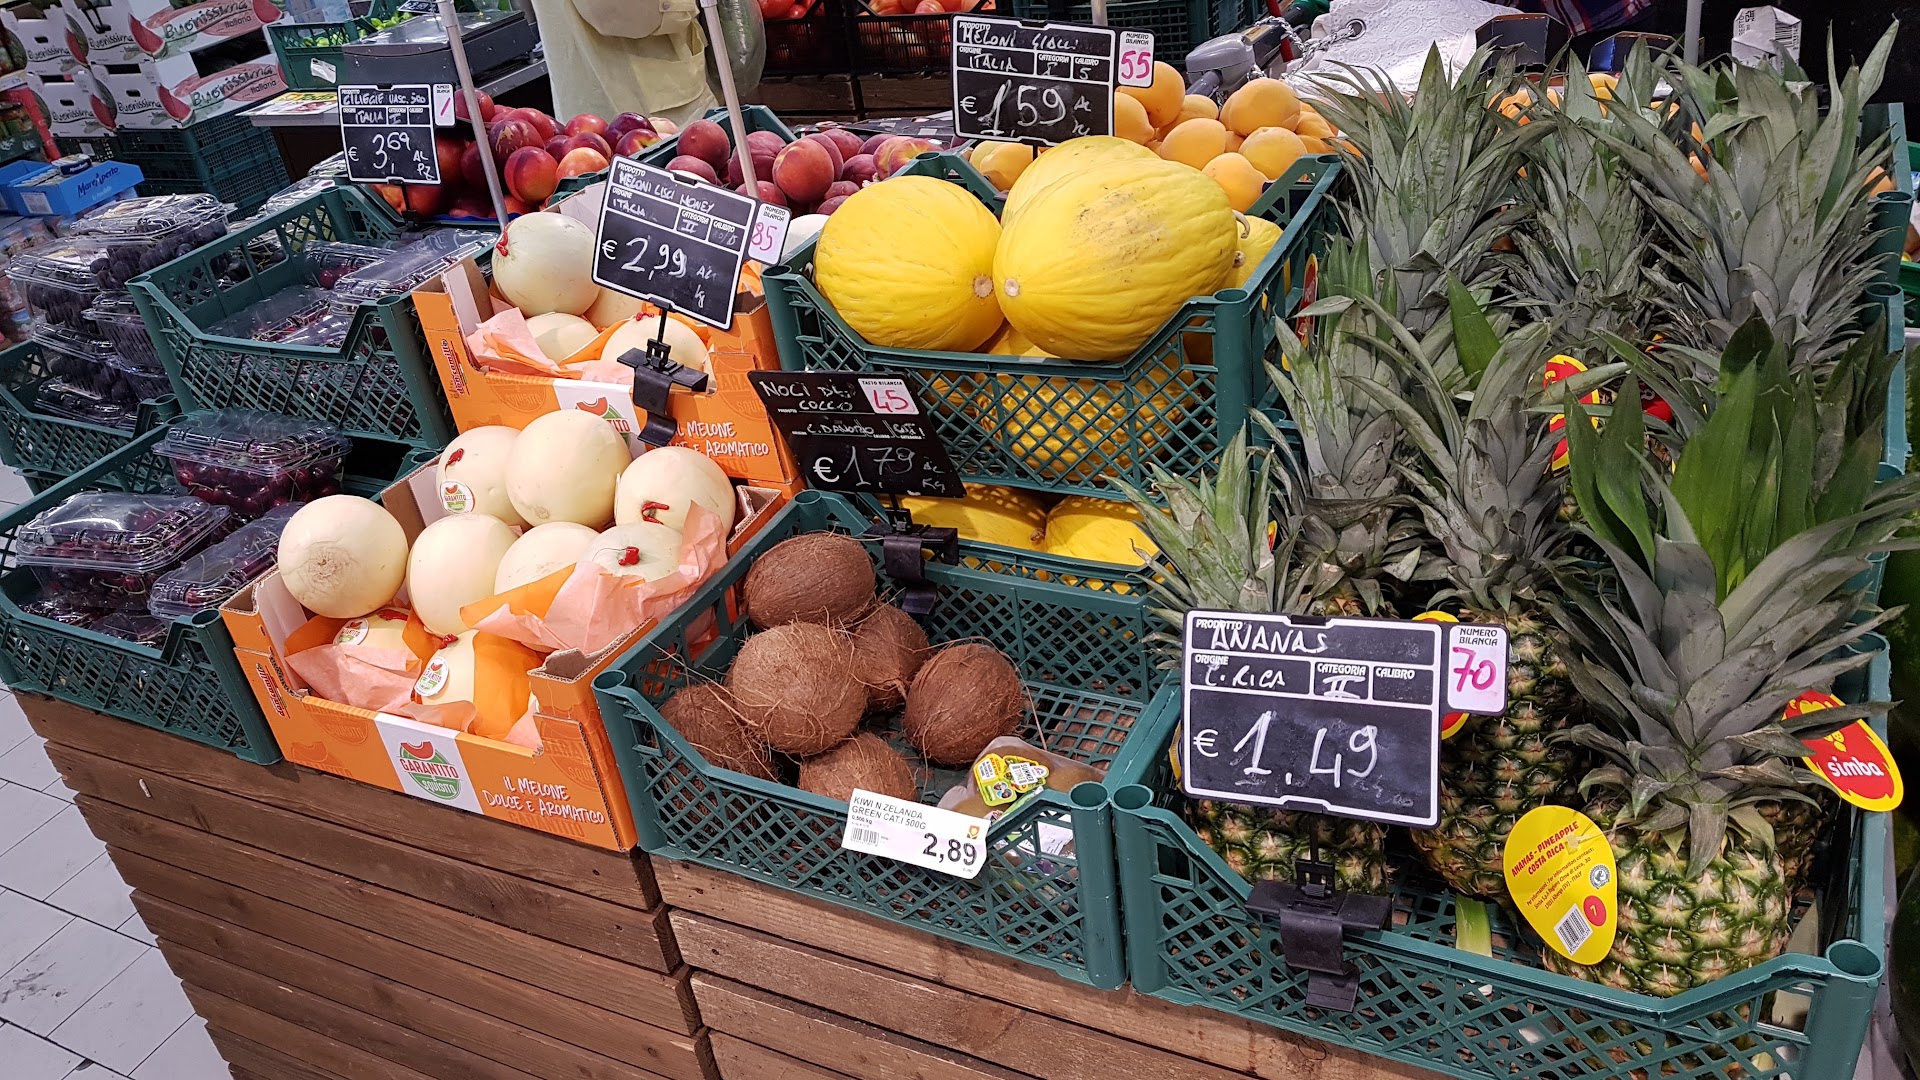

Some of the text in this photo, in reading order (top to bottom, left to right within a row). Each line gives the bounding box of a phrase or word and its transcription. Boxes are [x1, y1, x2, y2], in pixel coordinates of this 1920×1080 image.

[164, 1, 249, 39] Buonissima
[959, 22, 990, 31] PRODOTTO
[969, 54, 1018, 72] ITALIA
[1038, 53, 1069, 63] CATEGORIA
[1075, 56, 1099, 66] CALIBRO
[1121, 51, 1151, 79] 55
[191, 65, 272, 105] Buonissima
[343, 93, 384, 105] CILIEGIE
[960, 96, 977, 114] €
[348, 147, 359, 161] €
[617, 163, 646, 176] PRODOTTO
[619, 172, 651, 192] MELONI
[654, 185, 676, 199] LISCI
[613, 198, 646, 217] ITALIA
[681, 219, 699, 233] II
[751, 222, 778, 251] 85
[602, 240, 617, 260] €
[759, 381, 811, 397] NOCI
[799, 400, 853, 412] COCCO
[873, 390, 910, 413] 45
[687, 420, 737, 438] MELONE
[705, 439, 769, 457] AROMATICO
[813, 457, 839, 483] €
[1195, 618, 1243, 632] PRODOTTO
[1459, 627, 1498, 637] NUMERO
[1211, 623, 1328, 654] ANANAS
[1458, 636, 1499, 647] BILANCIA
[1194, 654, 1229, 667] ORIGINE
[1316, 662, 1367, 677] CATEGORIA
[1452, 646, 1497, 693] 70
[1375, 665, 1416, 681] CALIBRO
[1323, 674, 1366, 700] II
[1193, 729, 1219, 758] €
[400, 758, 459, 779] GARANTITO
[1827, 756, 1885, 777] simba
[503, 775, 570, 801] IL MELONE
[482, 790, 605, 824] DOLCE E AROMATICO
[853, 796, 873, 808] KIWI
[851, 806, 882, 819] GREEN
[905, 818, 927, 830] 500G
[922, 832, 977, 866] 2,89
[1511, 851, 1535, 877] ANANAS
[1537, 821, 1579, 853] PINEAPPLE
[1527, 842, 1565, 875] COSTA RICA
